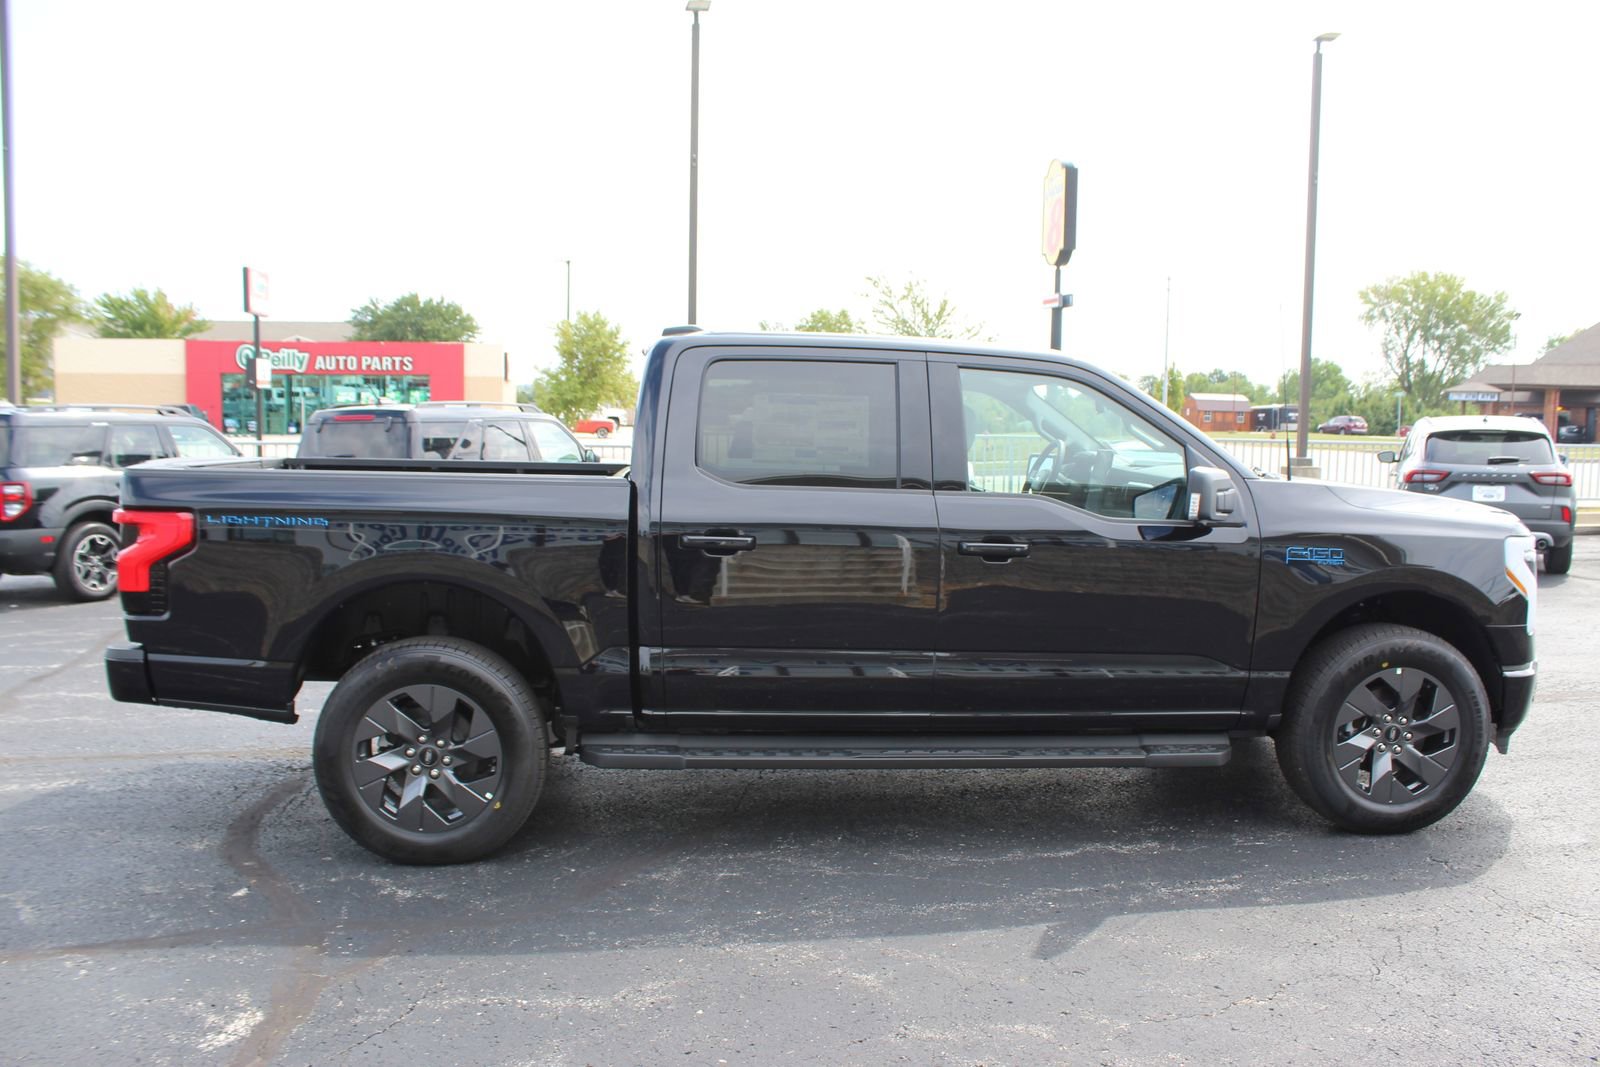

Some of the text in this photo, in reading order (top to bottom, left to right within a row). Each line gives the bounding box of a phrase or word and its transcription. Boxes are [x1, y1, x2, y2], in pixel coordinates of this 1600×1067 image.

[314, 355, 358, 371] AUTO
[361, 356, 414, 371] PARTS
[206, 514, 330, 528] LIGHTNING
